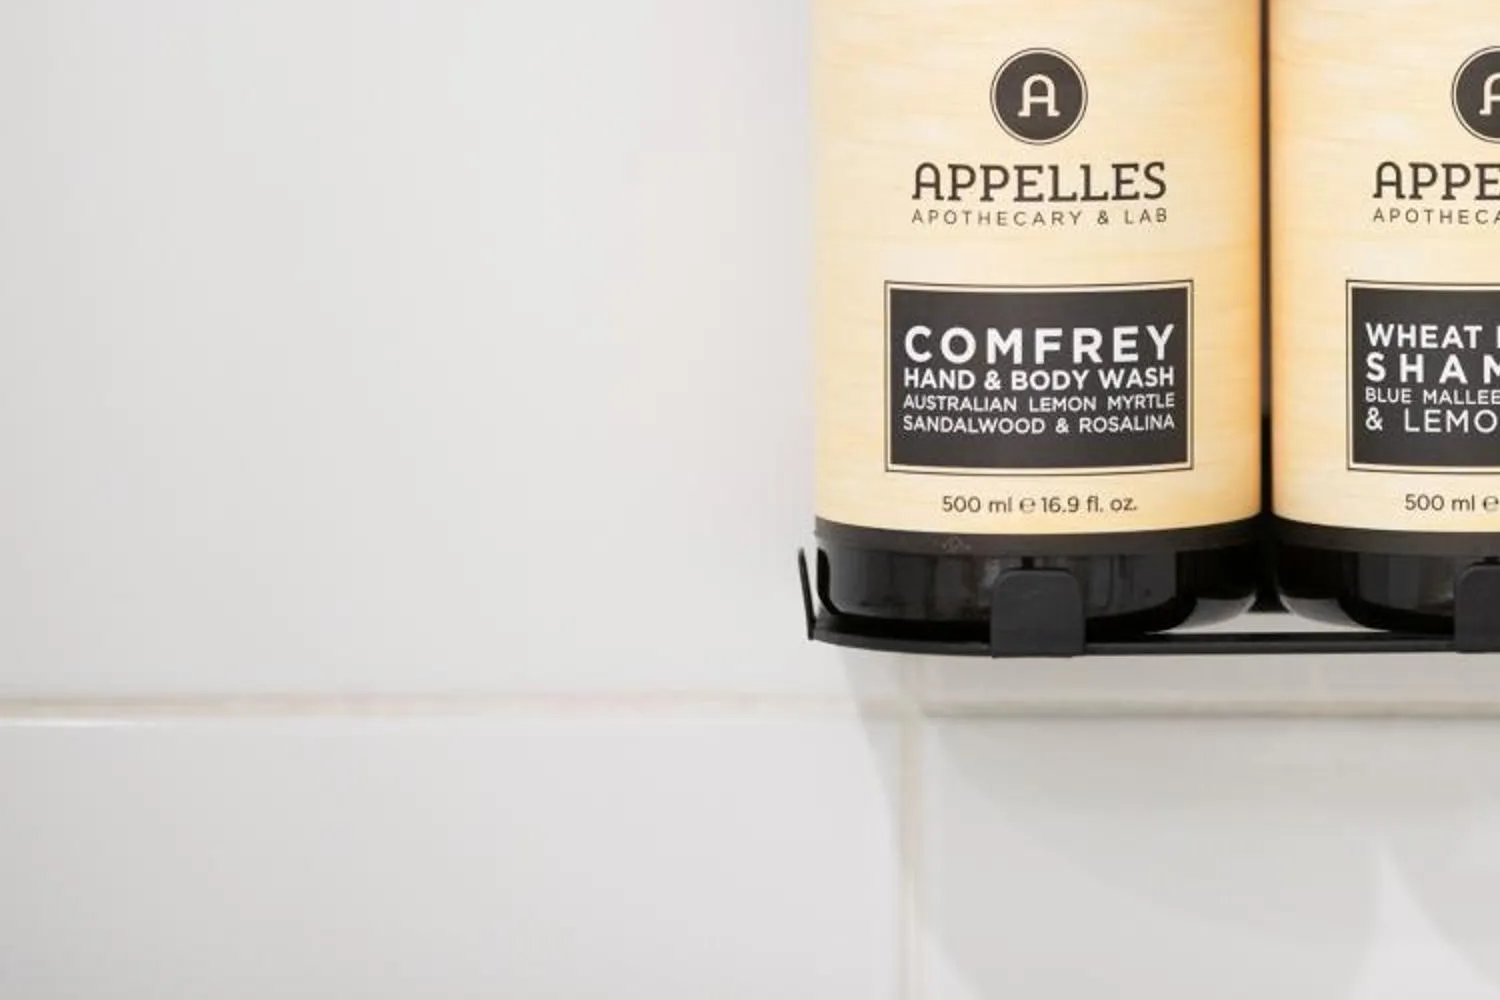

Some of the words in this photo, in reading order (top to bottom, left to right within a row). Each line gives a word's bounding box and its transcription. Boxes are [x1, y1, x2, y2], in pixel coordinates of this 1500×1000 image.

[1017, 73, 1061, 117] A
[911, 161, 1167, 203] APPELLES
[911, 208, 1083, 227] APOTHECARY
[1096, 209, 1109, 226] &
[1124, 207, 1168, 225] LAB
[904, 323, 1174, 365] COMFREY
[1365, 322, 1483, 349] WHEAT
[904, 367, 976, 391] HAND
[983, 369, 1002, 391] &
[1010, 369, 1090, 391] BODY
[1097, 365, 1174, 390] WASH
[903, 393, 1017, 413] AUSTRALIAN
[1028, 395, 1097, 413] LEMON
[1107, 391, 1175, 411] MYRTLE
[1365, 386, 1412, 405] BLUE
[903, 414, 1046, 435] SANDALWOOD
[1055, 417, 1070, 434] &
[1078, 413, 1175, 434] ROSALINA
[1365, 406, 1383, 431] &
[942, 495, 982, 513] 500
[987, 496, 1013, 513] ml
[1041, 495, 1080, 514] 16.9
[1086, 495, 1104, 513] fl.
[1109, 497, 1138, 513] oz.
[1404, 493, 1445, 512] 500
[1451, 494, 1476, 512] ml
